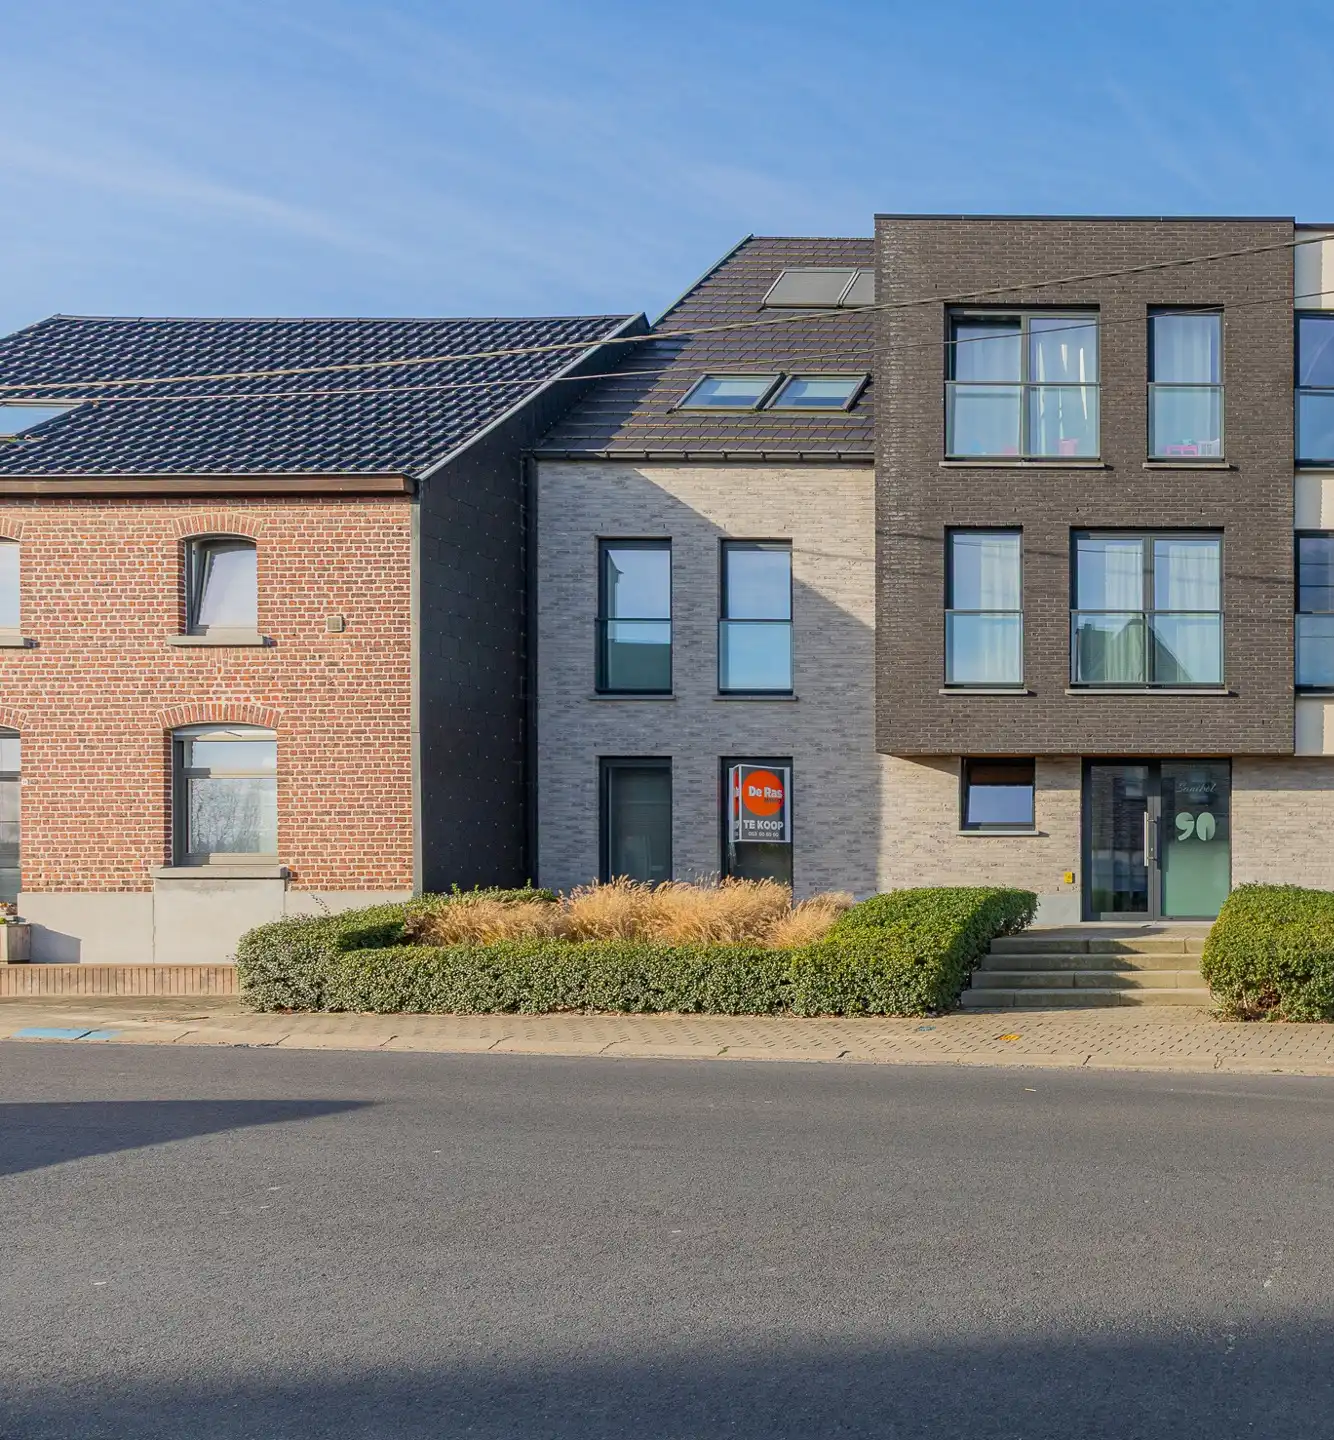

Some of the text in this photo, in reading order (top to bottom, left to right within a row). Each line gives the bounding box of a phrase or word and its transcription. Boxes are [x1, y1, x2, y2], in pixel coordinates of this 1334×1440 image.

[748, 786, 762, 797] De
[763, 786, 782, 798] Ras
[743, 820, 756, 830] TE
[757, 820, 784, 830] KOOP
[1175, 811, 1216, 841] 90
